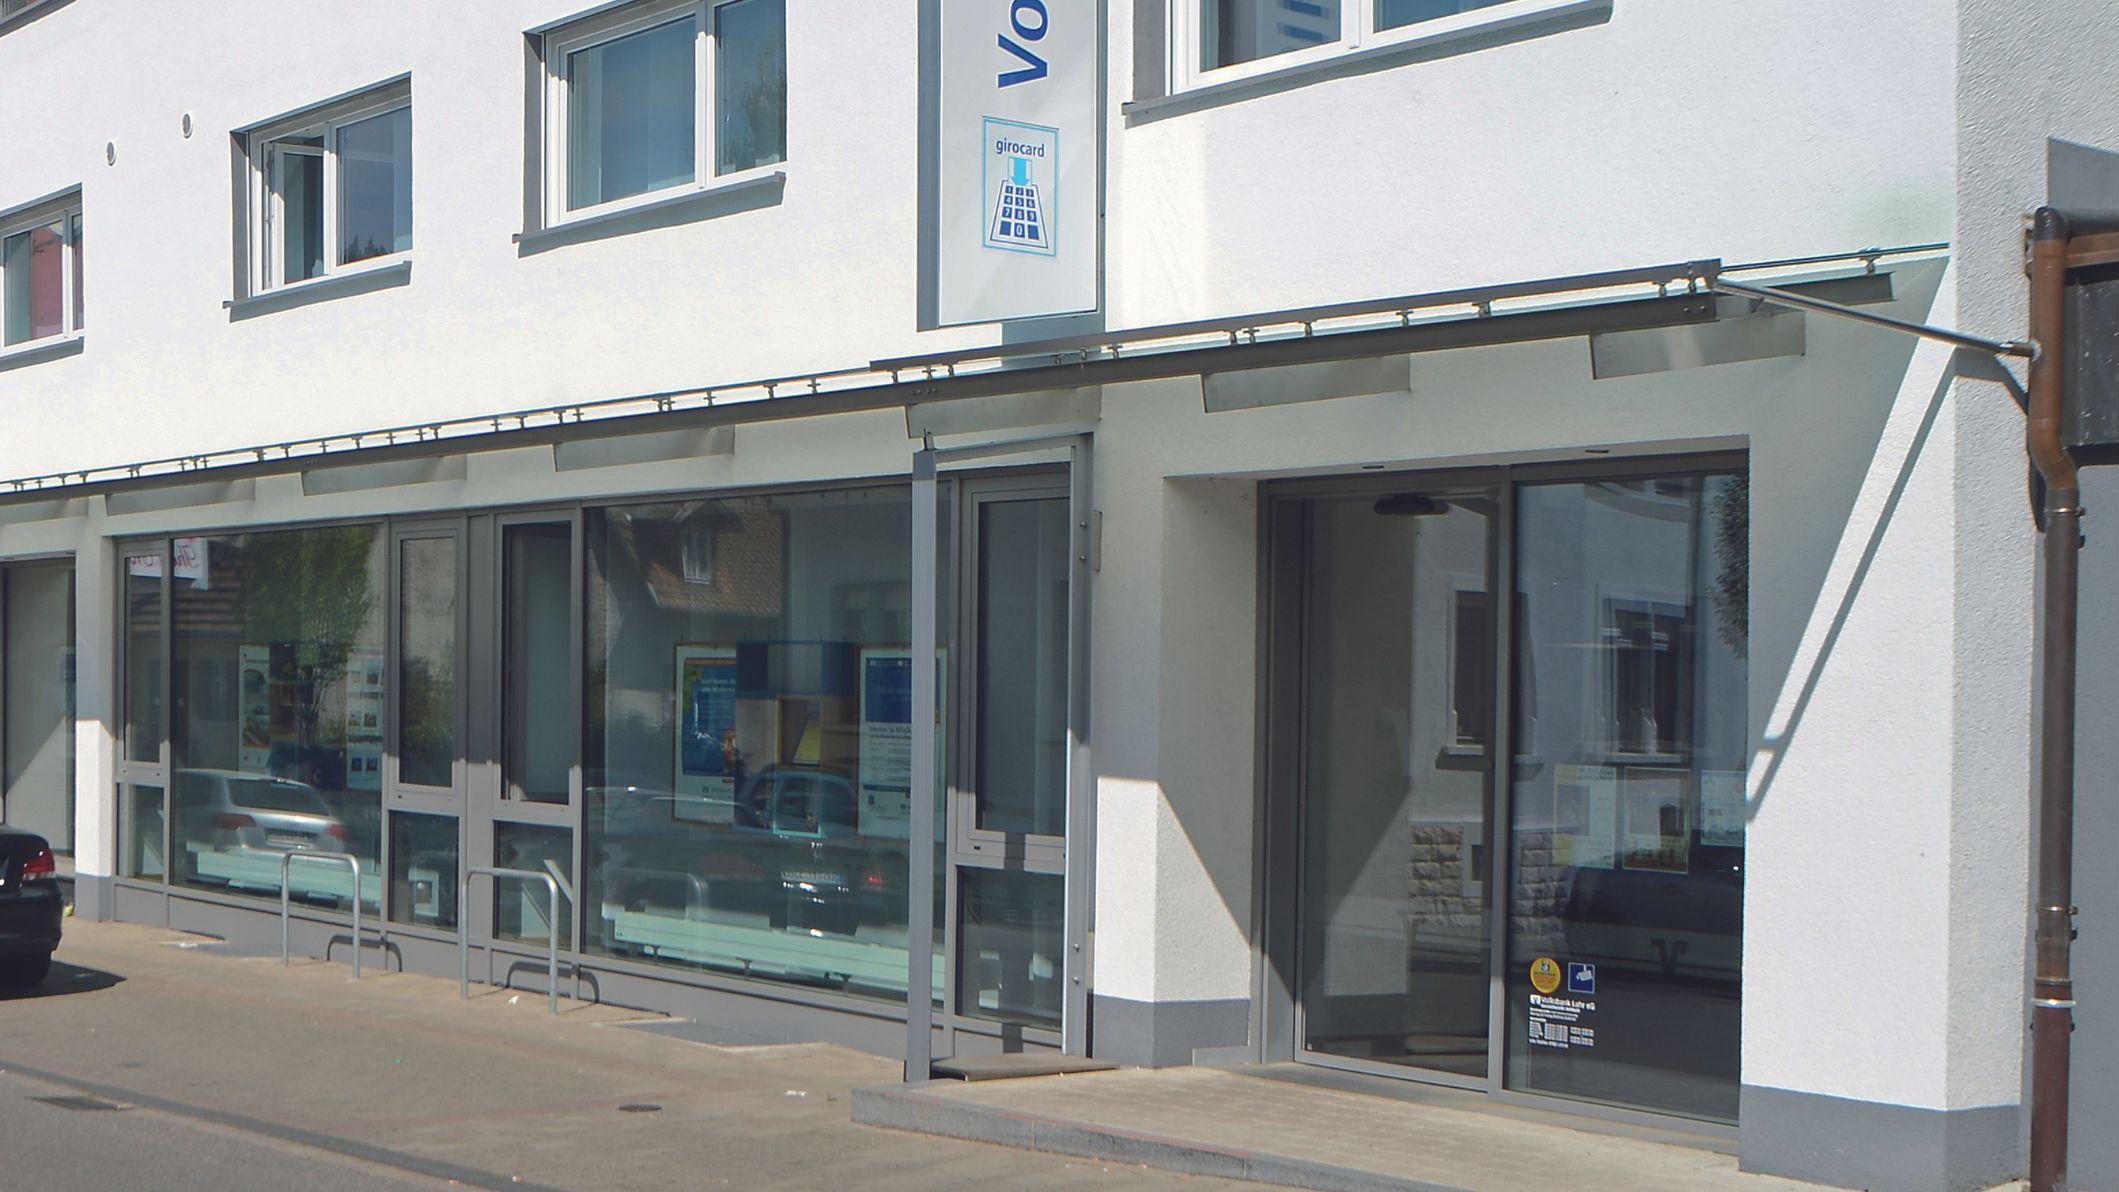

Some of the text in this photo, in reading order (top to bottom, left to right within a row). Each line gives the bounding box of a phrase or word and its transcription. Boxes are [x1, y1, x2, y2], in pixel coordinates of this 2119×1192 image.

[998, 0, 1048, 88] Vo
[996, 138, 1045, 157] girocard
[1016, 224, 1023, 235] 0
